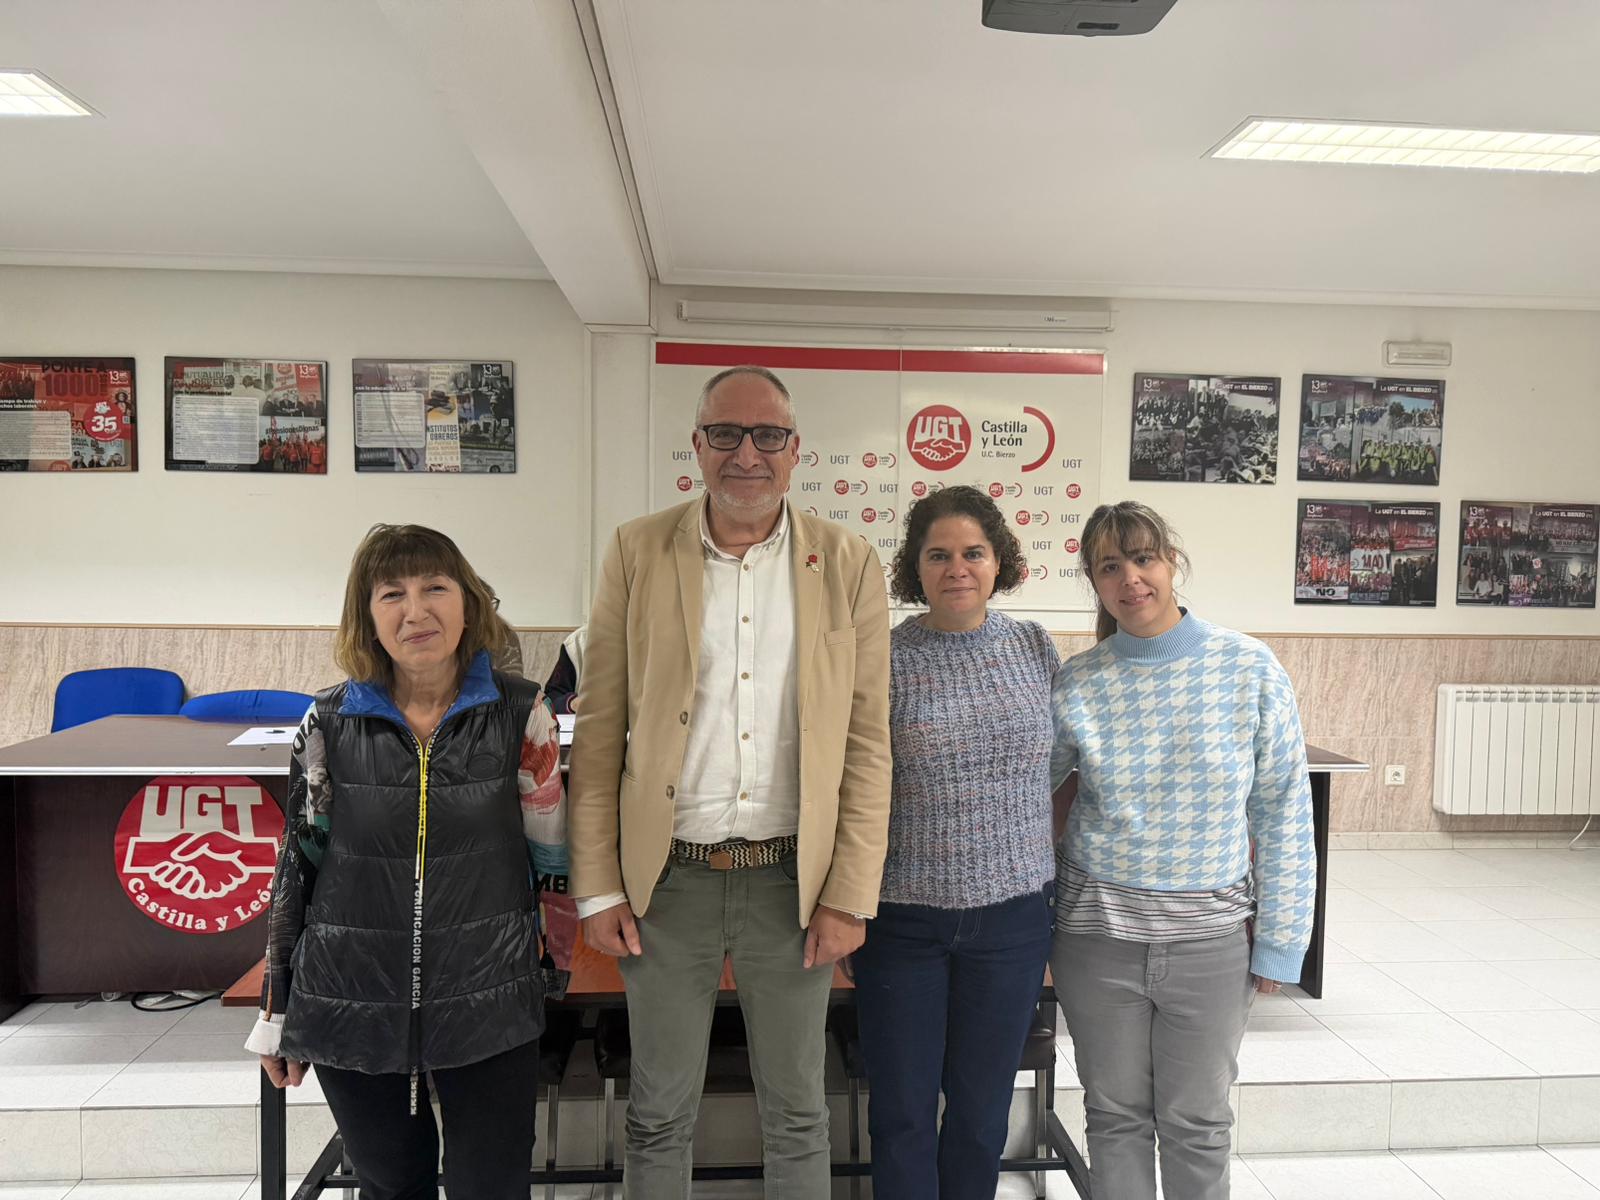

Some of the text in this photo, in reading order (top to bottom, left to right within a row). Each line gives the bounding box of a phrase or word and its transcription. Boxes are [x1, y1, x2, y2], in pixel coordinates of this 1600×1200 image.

[91, 415, 118, 432] 35
[981, 420, 1027, 433] Castilla
[914, 416, 962, 442] UGT
[981, 434, 1023, 448] y León
[672, 451, 692, 461] UGT
[830, 455, 850, 465] UGT
[1062, 459, 1082, 468] UGT
[802, 482, 822, 491] UGT
[880, 484, 899, 493] UGT
[1033, 486, 1054, 495] UGT
[829, 510, 849, 520] UGT
[1061, 514, 1081, 523] UGT
[878, 539, 898, 548] UGT
[1032, 541, 1052, 550] UGT
[1059, 568, 1079, 578] UGT
[1315, 588, 1336, 597] NO
[139, 786, 263, 838] UGT
[128, 877, 207, 931] Castilla
[215, 915, 229, 931] y
[411, 967, 422, 1010] GARCIA
